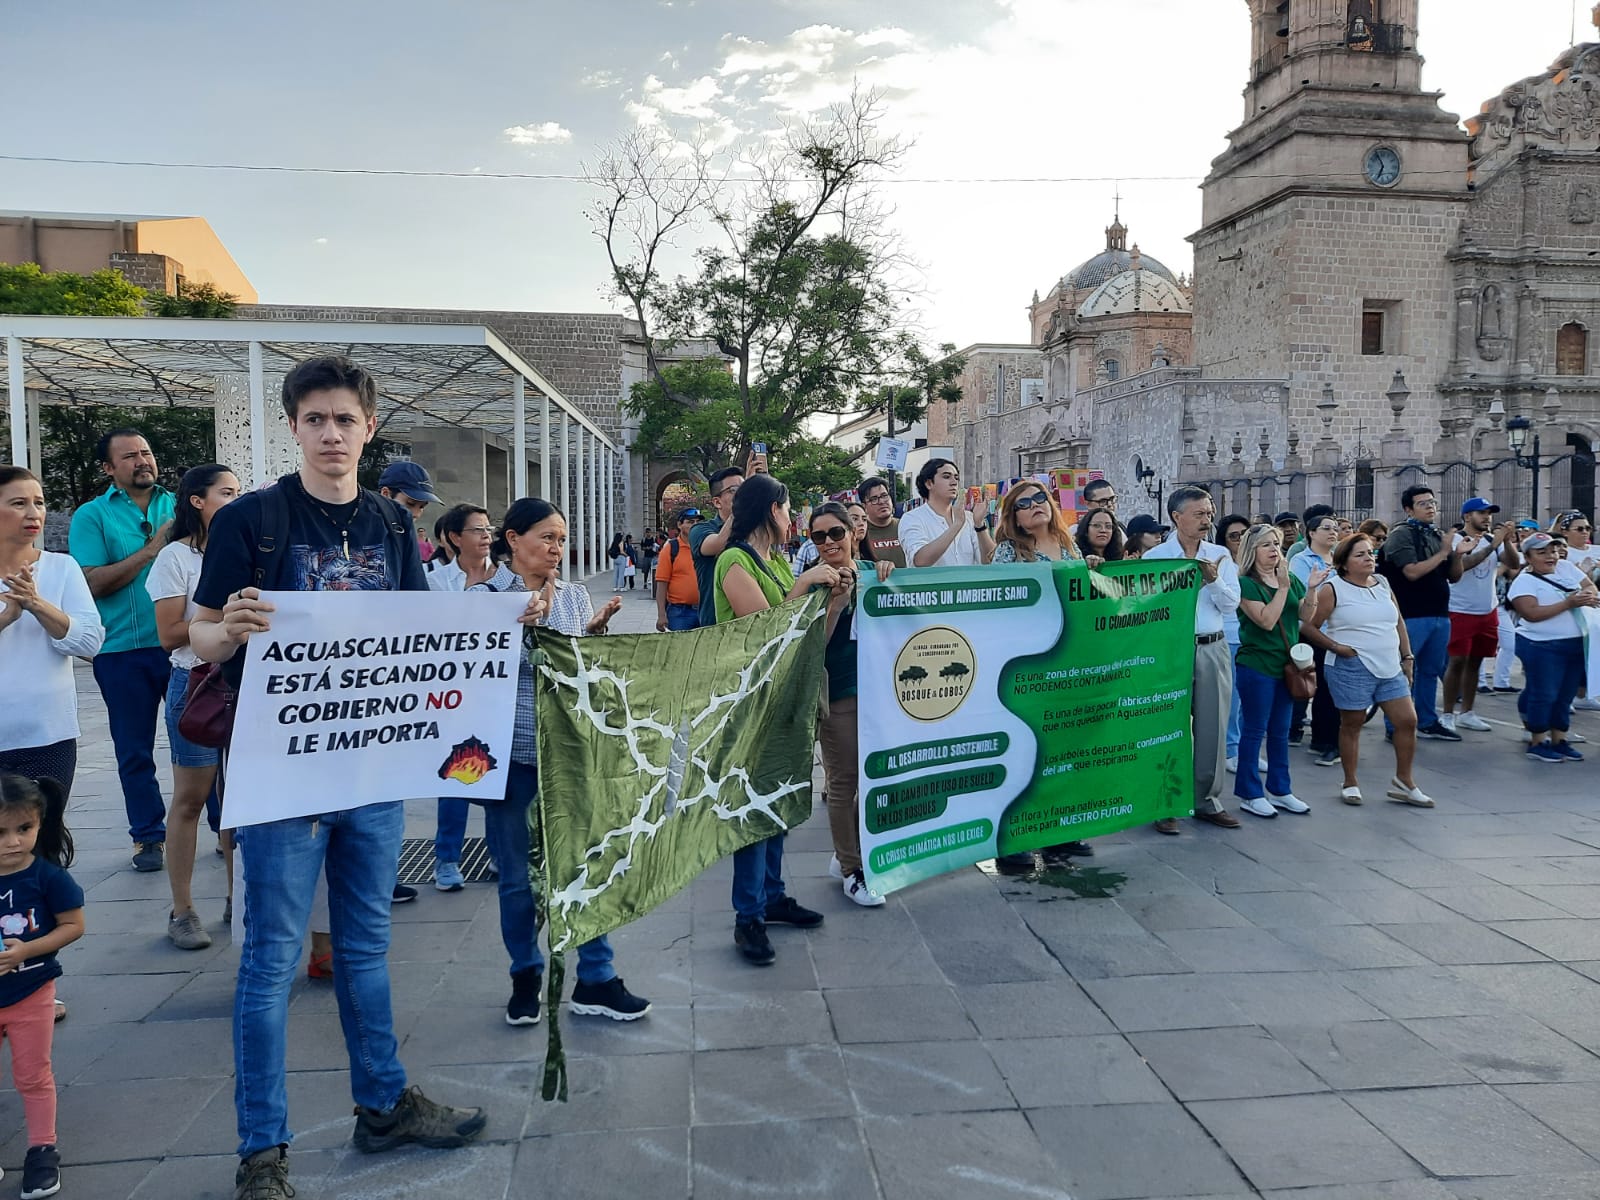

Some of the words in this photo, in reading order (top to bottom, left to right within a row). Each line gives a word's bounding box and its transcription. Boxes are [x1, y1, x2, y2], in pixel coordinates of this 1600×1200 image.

[877, 591, 938, 609] MERECEMOS
[940, 590, 953, 605] UN
[956, 587, 1002, 604] AMBIENTE
[1005, 586, 1028, 600] SANO
[1069, 578, 1085, 602] EL
[1089, 575, 1137, 601] BOQUE
[1139, 573, 1157, 596] DE
[1095, 616, 1106, 631] LO
[1108, 611, 1148, 630] CUIDAMOS
[261, 632, 480, 662] AGUASCALIENTES
[485, 631, 511, 650] SE
[266, 666, 332, 694] ESTÁ
[339, 661, 457, 689] SECANDO
[462, 661, 477, 679] Y
[480, 660, 509, 679] AL
[1014, 684, 1027, 695] NO
[1029, 680, 1072, 693] PODEMOS
[1015, 672, 1026, 683] Es
[1027, 673, 1044, 682] una
[1045, 669, 1067, 680] zona
[1068, 666, 1080, 677] de
[278, 693, 419, 725] GOBIERNO
[425, 689, 463, 711] NO
[902, 688, 931, 702] BOSQUE
[939, 685, 963, 698] COBOS
[1044, 710, 1054, 720] Es
[1056, 709, 1071, 719] una
[1073, 706, 1083, 715] de
[1152, 692, 1161, 702] de
[1042, 722, 1059, 734] que
[1061, 720, 1075, 729] nos
[1105, 711, 1115, 720] en
[1117, 702, 1174, 720] Aguascalientes
[287, 733, 320, 755] LE
[326, 721, 440, 752] IMPORTA
[888, 756, 897, 770] AL
[899, 745, 948, 766] DESARROLLO
[950, 739, 999, 757] SOSTENIBLE
[1042, 766, 1056, 776] del
[1057, 763, 1073, 773] aire
[1074, 760, 1090, 772] que
[1092, 753, 1137, 768] respiramos
[1044, 754, 1058, 765] Los
[1091, 743, 1127, 756] depuran
[876, 793, 888, 809] NO
[889, 793, 899, 805] AL
[901, 786, 928, 802] CAMBIO
[930, 782, 939, 794] DE
[941, 778, 957, 792] USO
[959, 776, 968, 789] DE
[970, 771, 994, 787] SUELO
[876, 813, 887, 828] EN
[888, 809, 902, 824] LOS
[904, 800, 936, 820] BOSQUES
[1009, 815, 1019, 825] La
[1021, 810, 1041, 822] flora
[1043, 809, 1049, 819] y
[1050, 805, 1075, 817] fauna
[1077, 799, 1107, 811] nativas
[1108, 796, 1123, 806] son
[1009, 824, 1038, 838] vitales
[1039, 820, 1058, 832] para
[1060, 810, 1099, 827] NUESTRO
[1100, 803, 1133, 819] FUTURO
[876, 854, 886, 867] LA
[885, 847, 907, 864] CRISIS
[942, 833, 956, 847] NOS
[957, 831, 965, 843] LO
[966, 825, 984, 841] EXIGE
